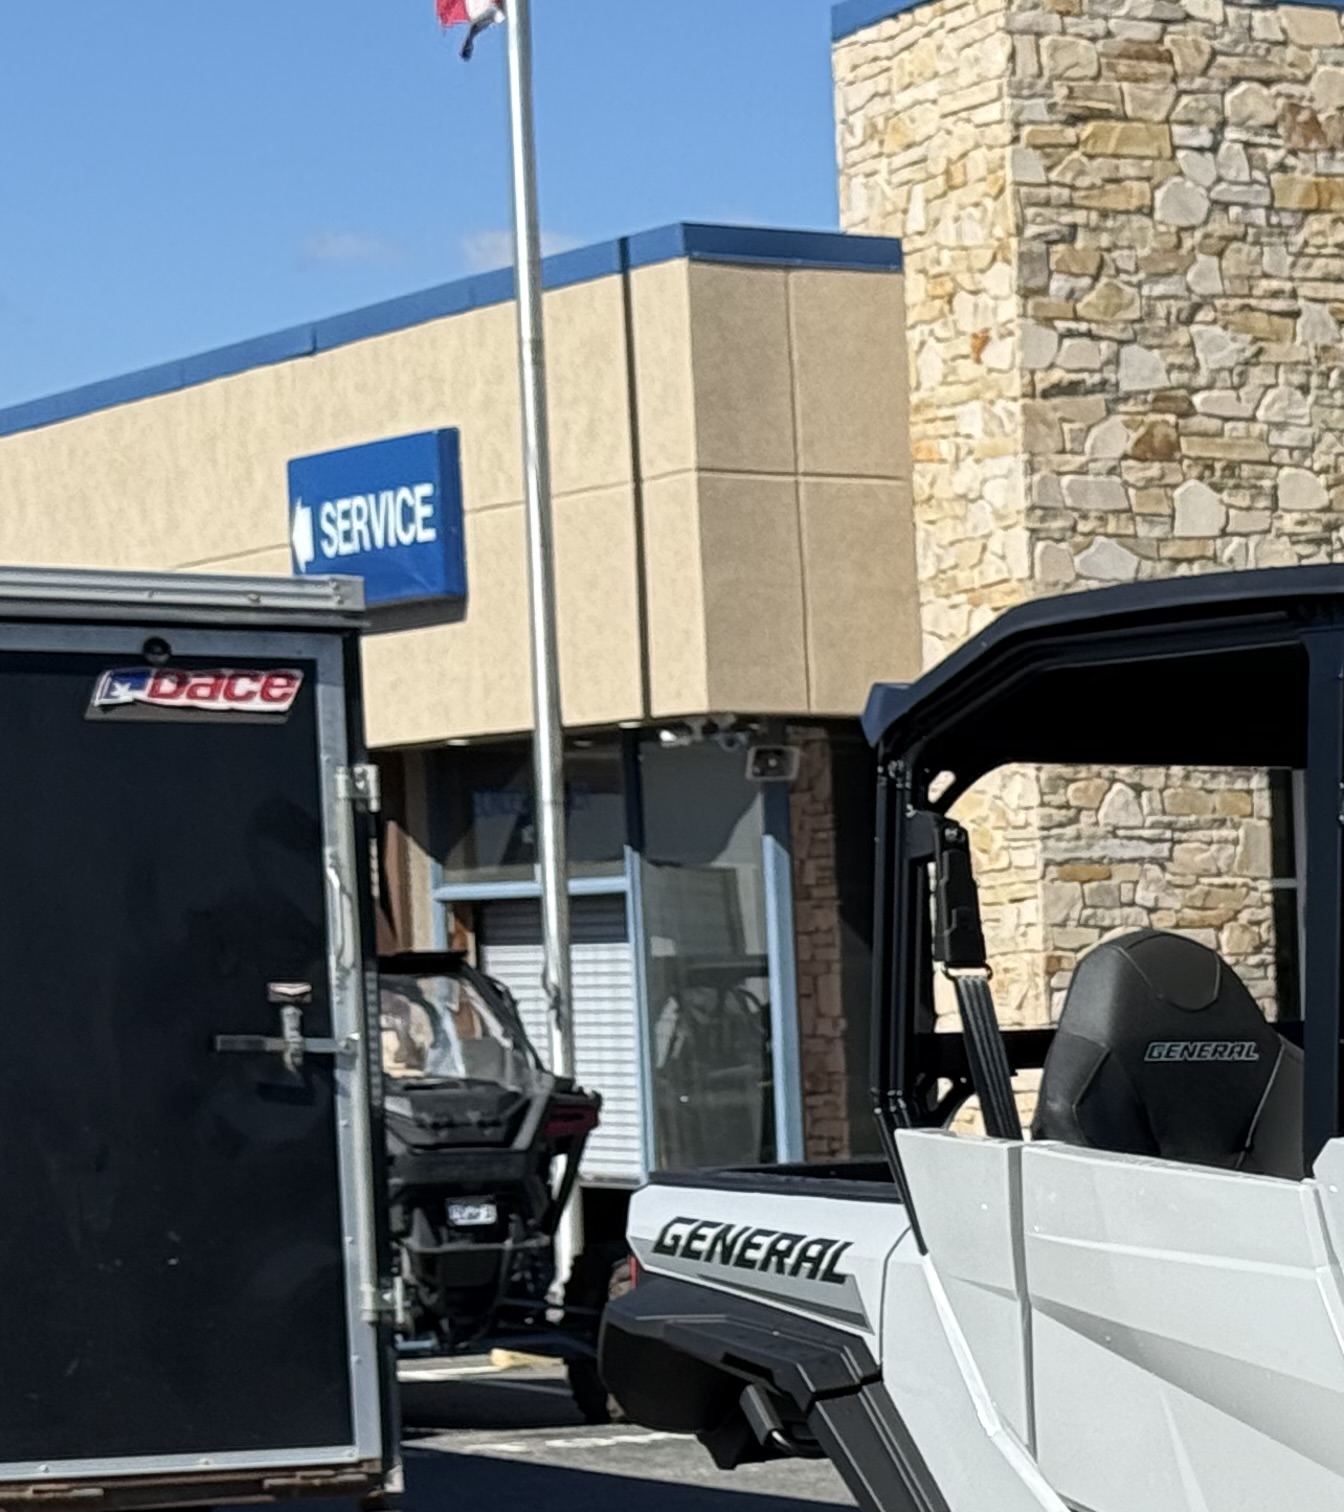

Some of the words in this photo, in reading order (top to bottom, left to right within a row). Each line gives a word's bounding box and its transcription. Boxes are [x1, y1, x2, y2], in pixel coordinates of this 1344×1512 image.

[318, 482, 437, 560] SERVICE
[1144, 1040, 1260, 1063] GENERAL
[651, 1215, 855, 1285] GENERAL
